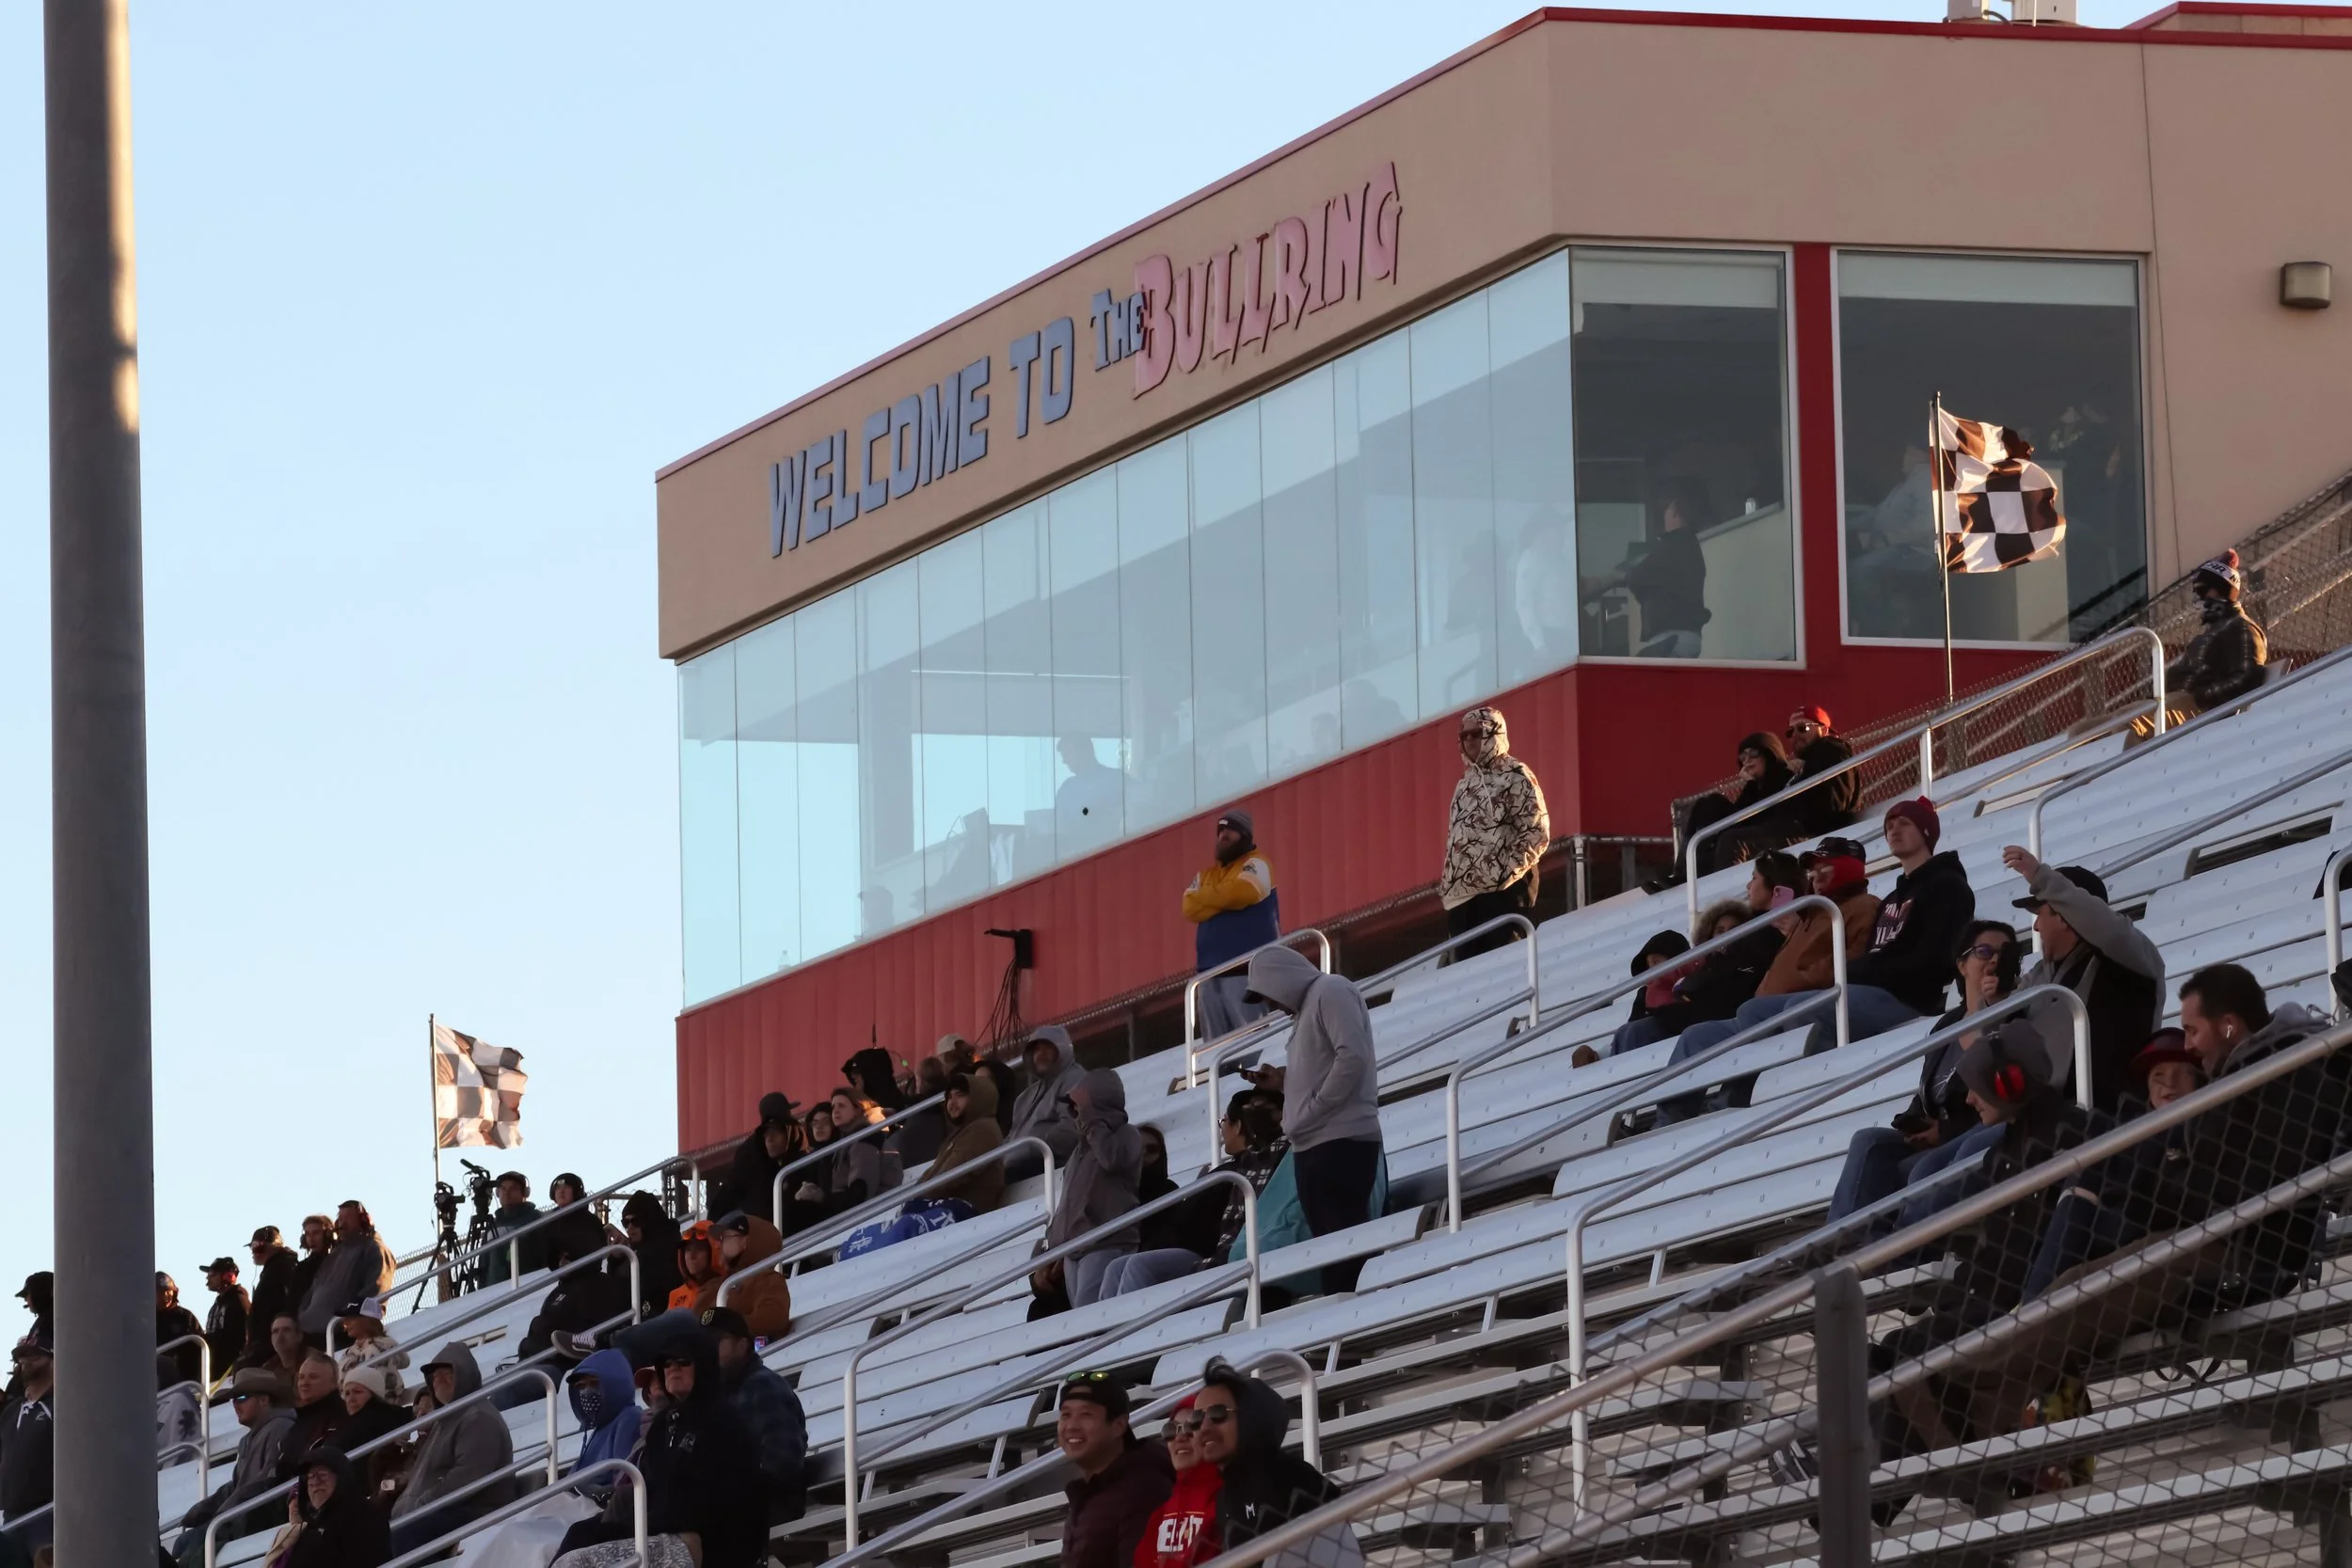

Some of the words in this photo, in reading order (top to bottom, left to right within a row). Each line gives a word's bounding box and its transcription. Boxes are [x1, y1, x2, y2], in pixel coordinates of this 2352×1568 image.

[769, 355, 991, 559] WELCOME
[1009, 315, 1074, 440] TO
[1090, 287, 1147, 372] THE
[1133, 161, 1403, 401] BULLRING
